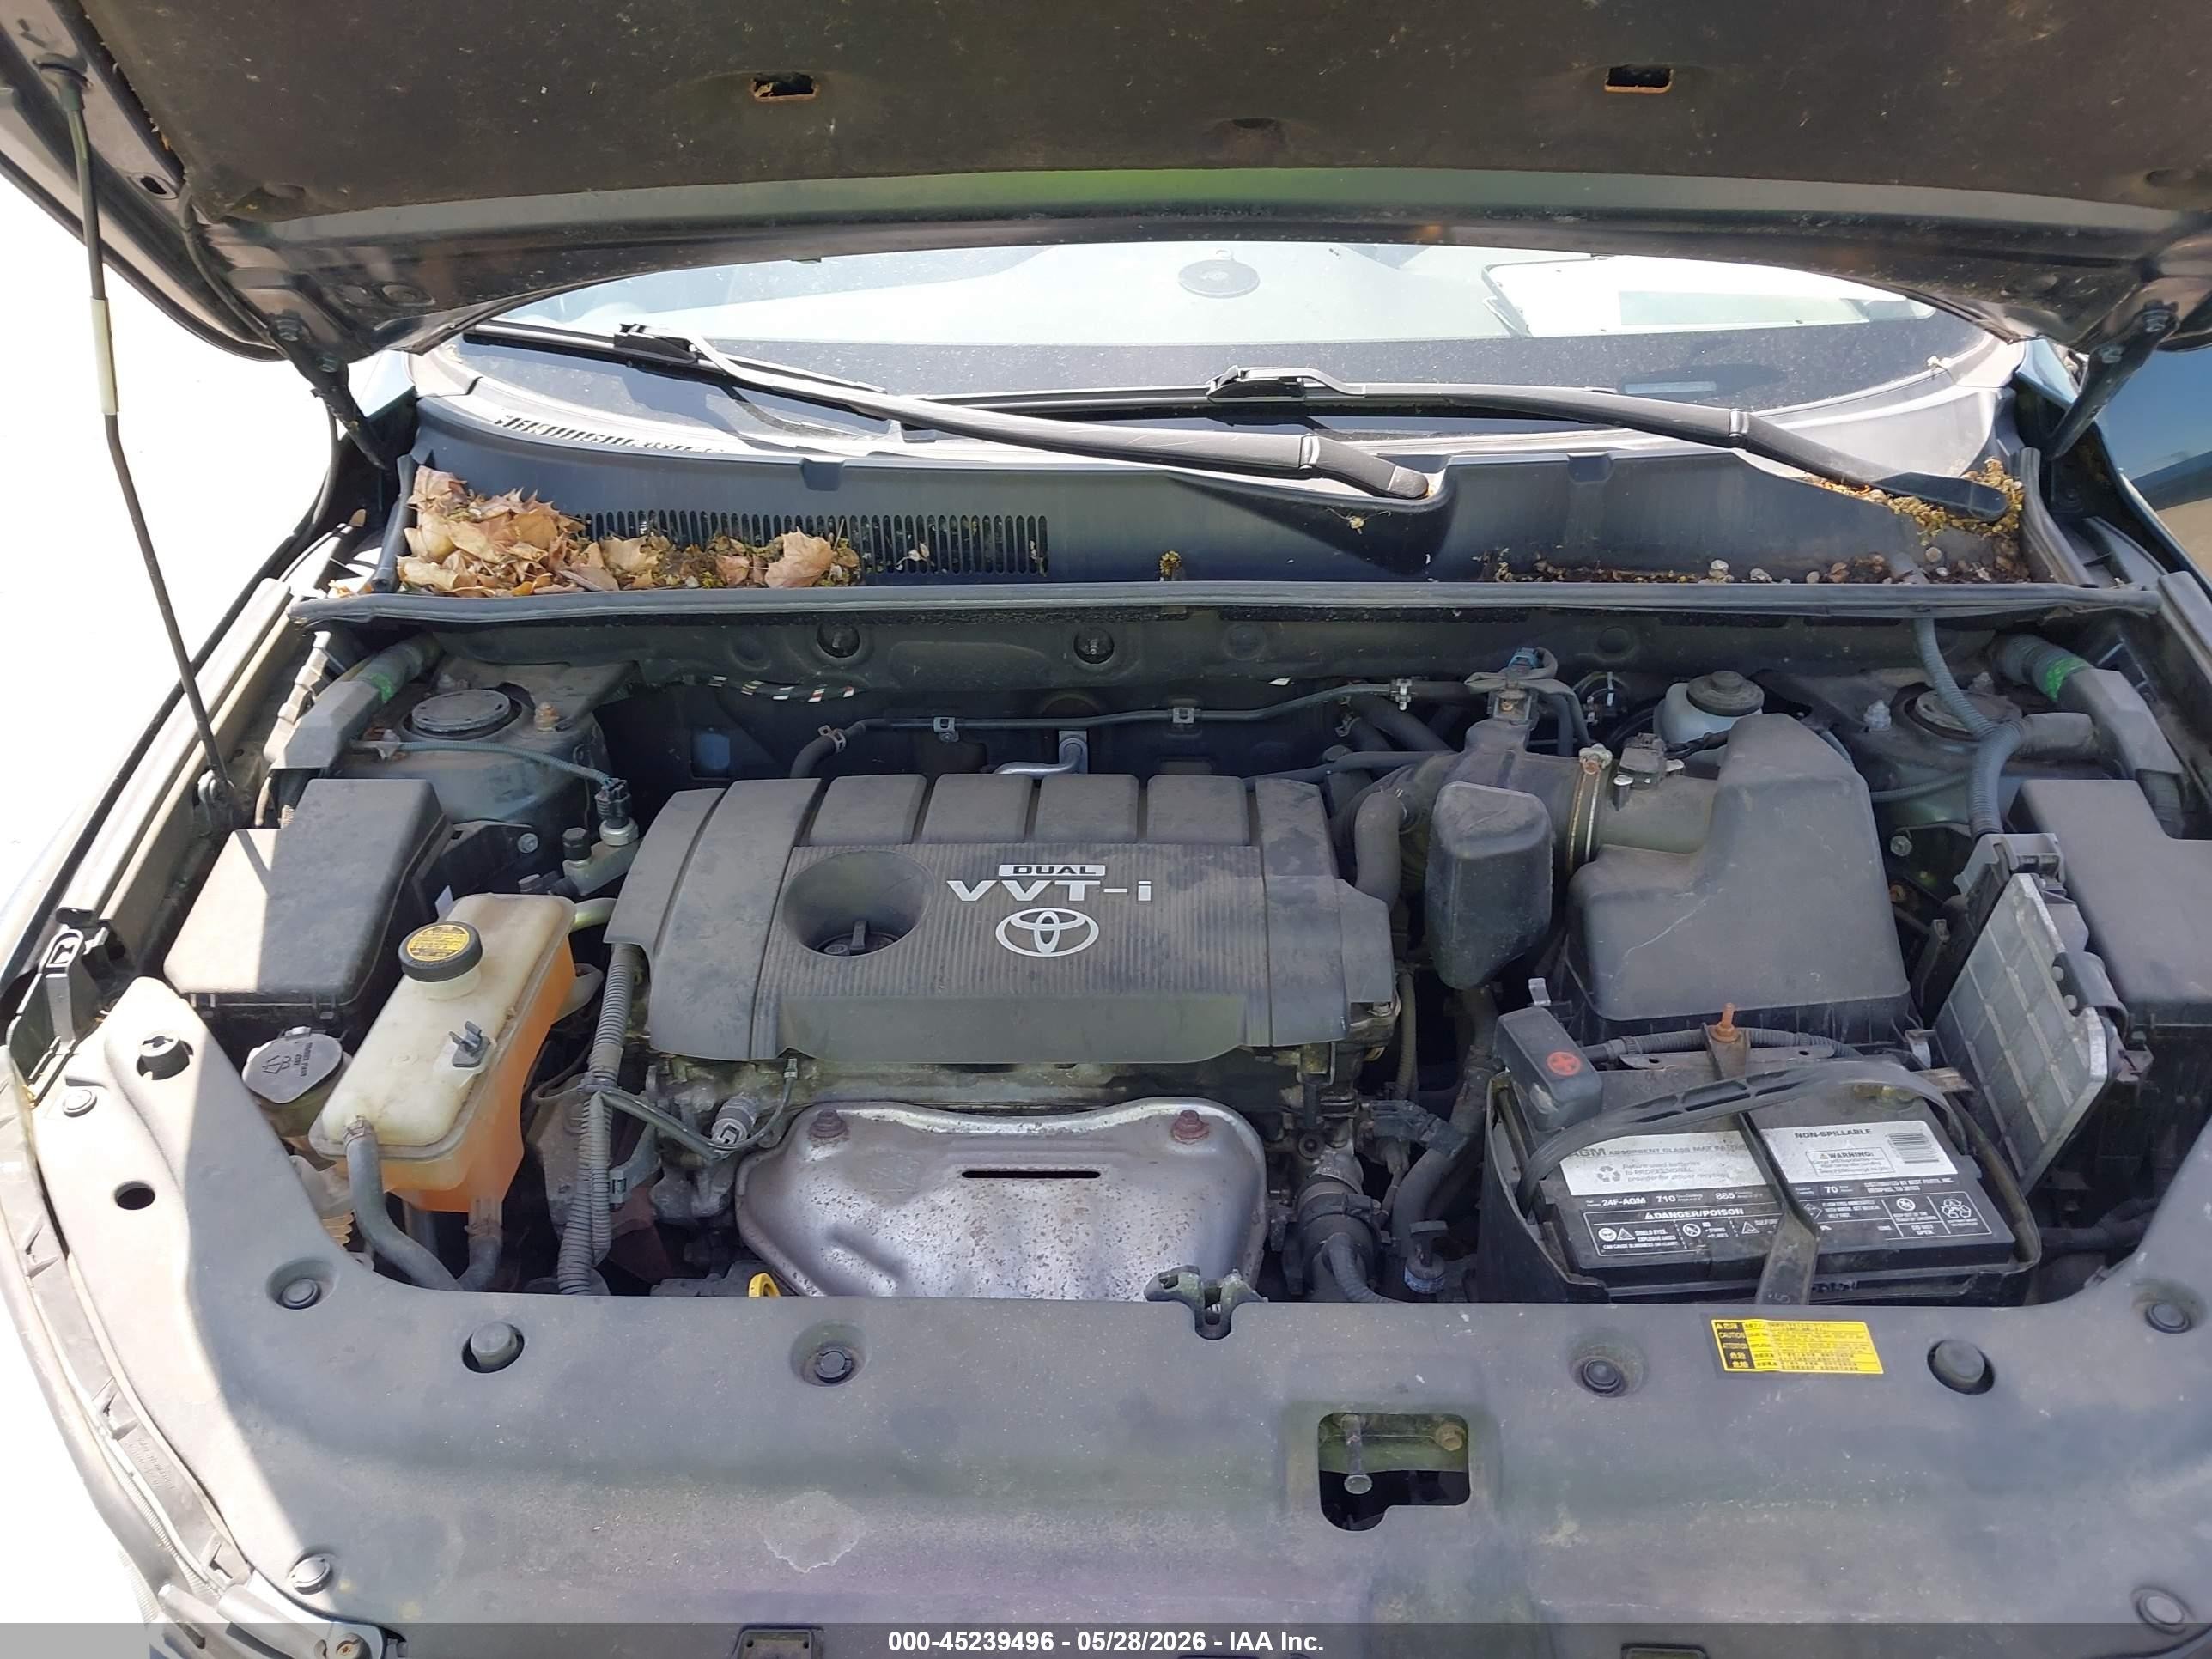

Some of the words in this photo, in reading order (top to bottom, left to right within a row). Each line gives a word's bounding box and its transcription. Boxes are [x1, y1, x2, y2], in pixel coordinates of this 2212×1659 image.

[1012, 866, 1097, 875] DUAL
[946, 880, 1152, 902] VVT-i
[1794, 1128, 1873, 1139] NON-SPILLABLE
[1601, 1197, 1647, 1206] 24F-AGM
[1654, 1208, 1745, 1219] DANGER/POISON
